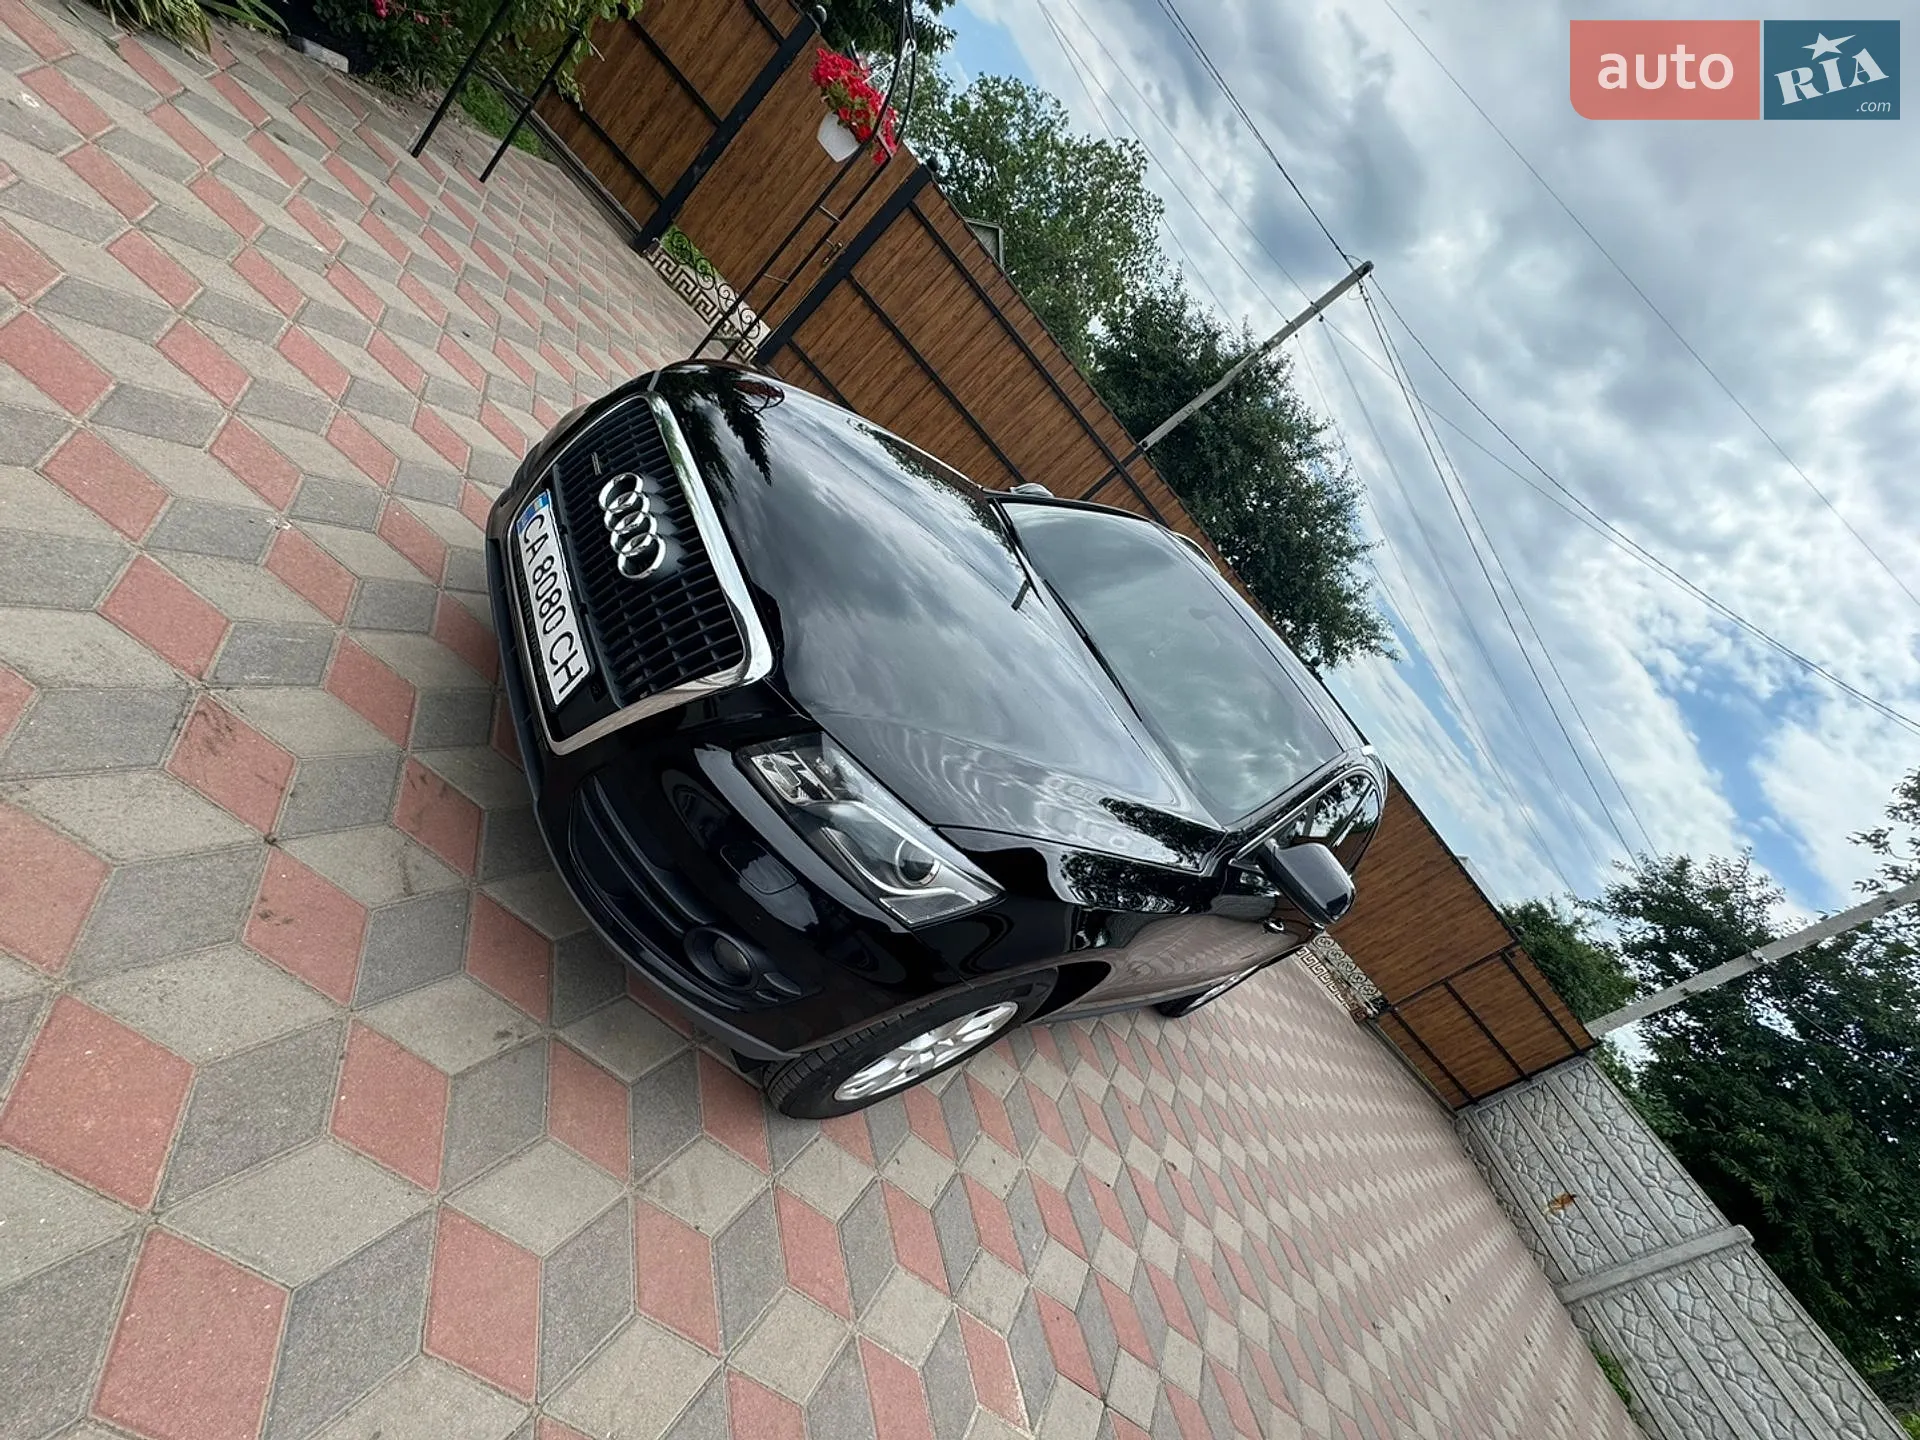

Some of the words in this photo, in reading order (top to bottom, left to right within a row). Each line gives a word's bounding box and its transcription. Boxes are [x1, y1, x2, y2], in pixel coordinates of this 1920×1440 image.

[523, 514, 549, 566] CA
[533, 555, 567, 635] 8080
[549, 630, 584, 694] CH
